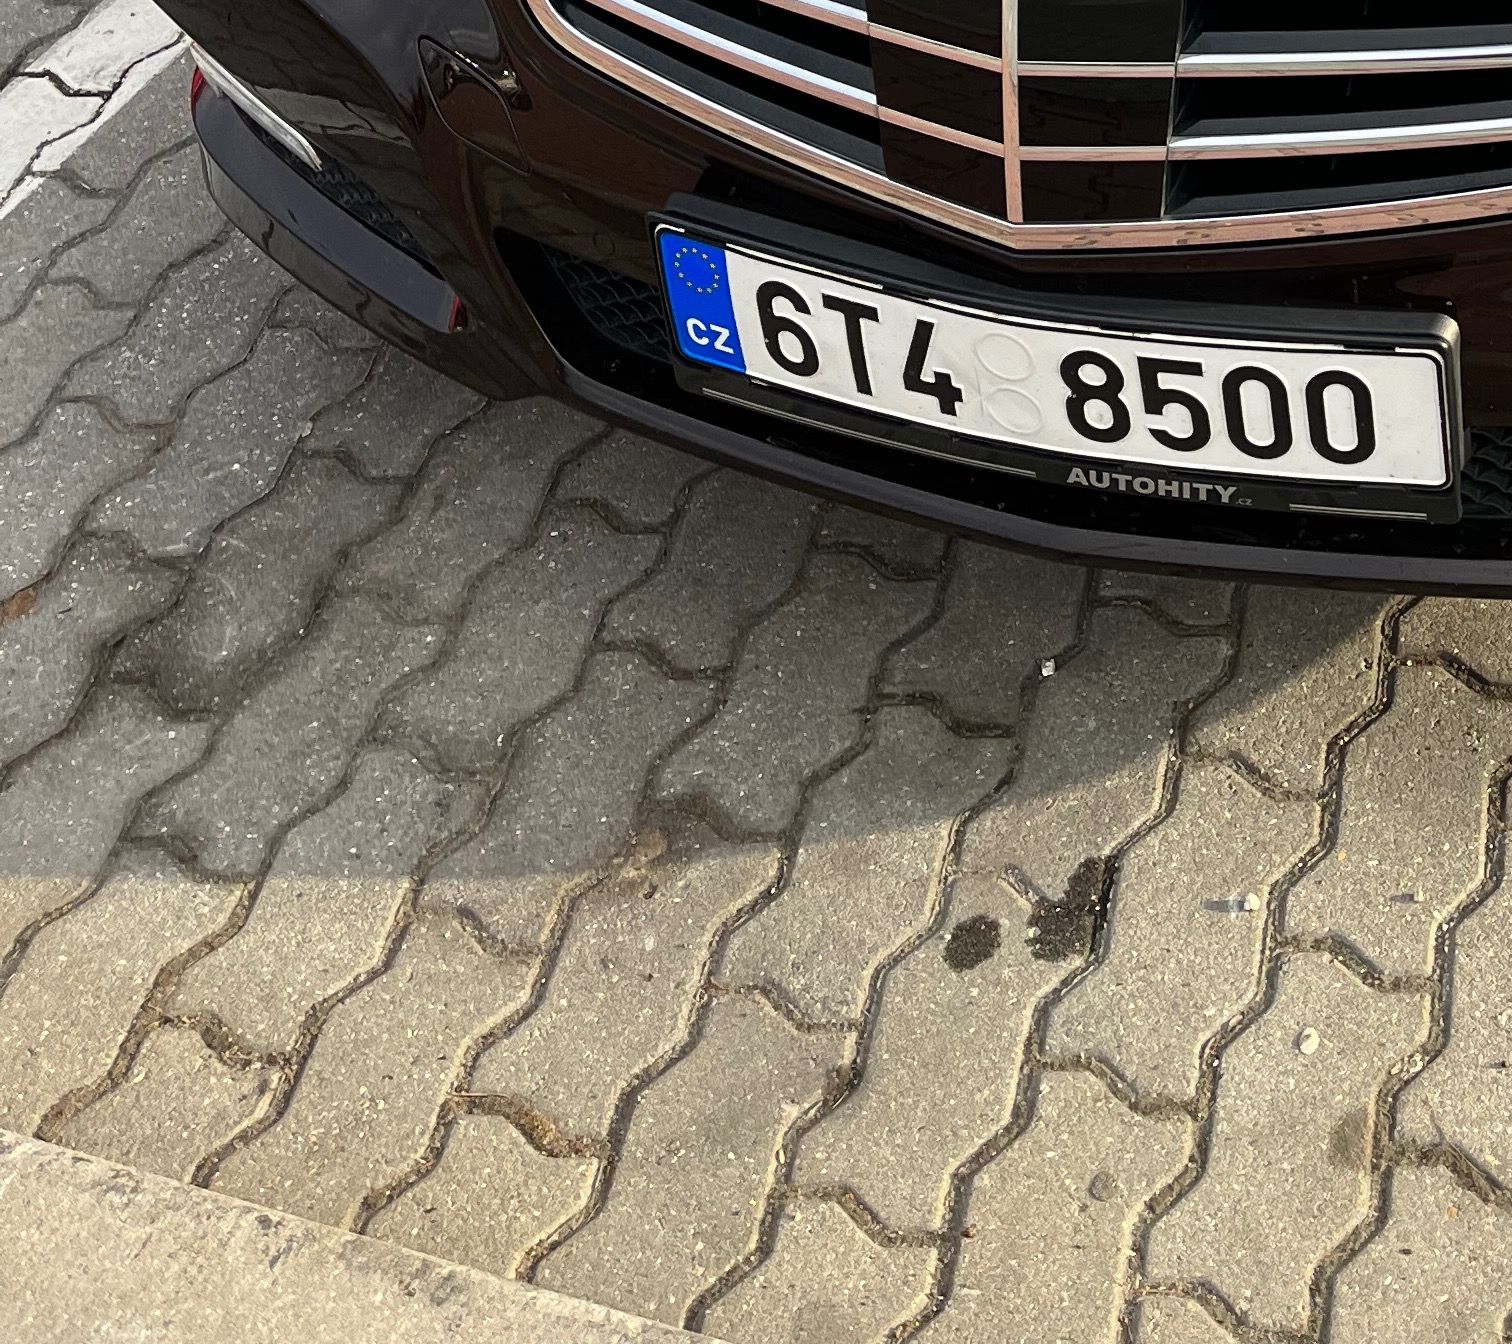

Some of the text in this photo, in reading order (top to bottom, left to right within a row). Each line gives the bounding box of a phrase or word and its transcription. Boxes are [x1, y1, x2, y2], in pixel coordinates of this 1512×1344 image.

[686, 318, 734, 354] CZ
[756, 280, 1377, 465] 6T4 8500
